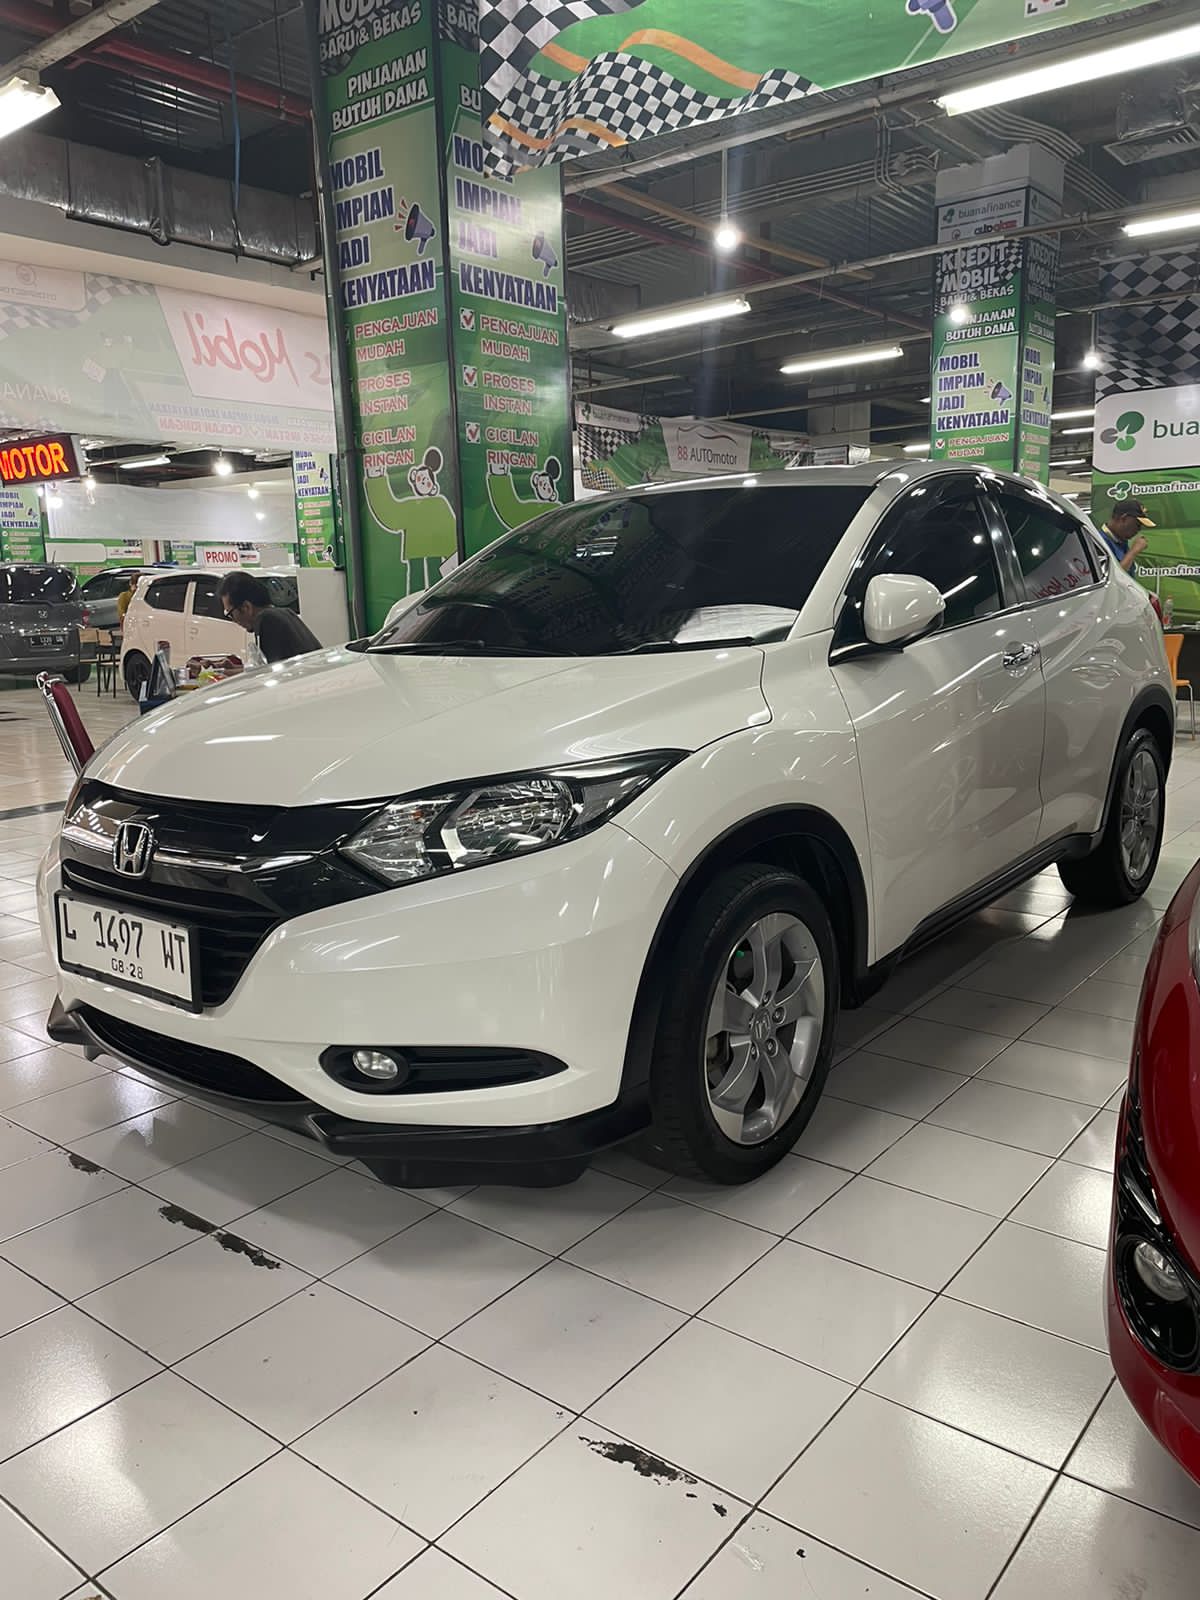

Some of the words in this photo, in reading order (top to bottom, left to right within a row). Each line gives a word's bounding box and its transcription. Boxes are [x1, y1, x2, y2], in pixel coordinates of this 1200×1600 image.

[447, 4, 480, 36] BAR
[320, 30, 355, 62] BARU
[359, 27, 369, 44] &
[373, 2, 421, 40] BEKAS
[348, 48, 427, 98] PINJAMAN
[332, 95, 381, 131] BUTUH
[385, 78, 428, 112] DANA
[331, 149, 384, 191] MOBIL
[456, 177, 522, 225] IMPIAN
[958, 199, 1022, 218] buanafinance
[458, 222, 498, 258] JADI
[941, 242, 1008, 273] KREDIT
[460, 262, 557, 313] KENYATAAN
[941, 265, 1000, 293] MOBIL
[980, 284, 1014, 300] BEKAS
[355, 309, 437, 340] PENGAJUAN
[480, 315, 559, 346] PENGAJUAN
[946, 327, 982, 341] BUTUH
[984, 321, 1015, 336] DANA
[356, 340, 405, 362] MUDAH
[481, 339, 530, 362] MUDAH
[939, 353, 980, 372] MOBIL
[358, 371, 411, 393] PROSES
[482, 371, 536, 393] PROSES
[938, 372, 985, 392] IMPIAN
[360, 395, 408, 416] INSTAN
[484, 395, 532, 416] INSTAN
[937, 395, 965, 412] JADI
[937, 409, 1009, 431] KENYATAAN
[1153, 419, 1200, 439] bua
[363, 427, 416, 446] CICILAN
[486, 427, 539, 447] CICILAN
[364, 450, 414, 469] RINGAN
[487, 450, 537, 469] RINGAN
[677, 446, 689, 461] 88
[206, 551, 238, 563] PROMO
[62, 903, 76, 940] L
[93, 911, 143, 958] 1497
[161, 929, 185, 974] WT
